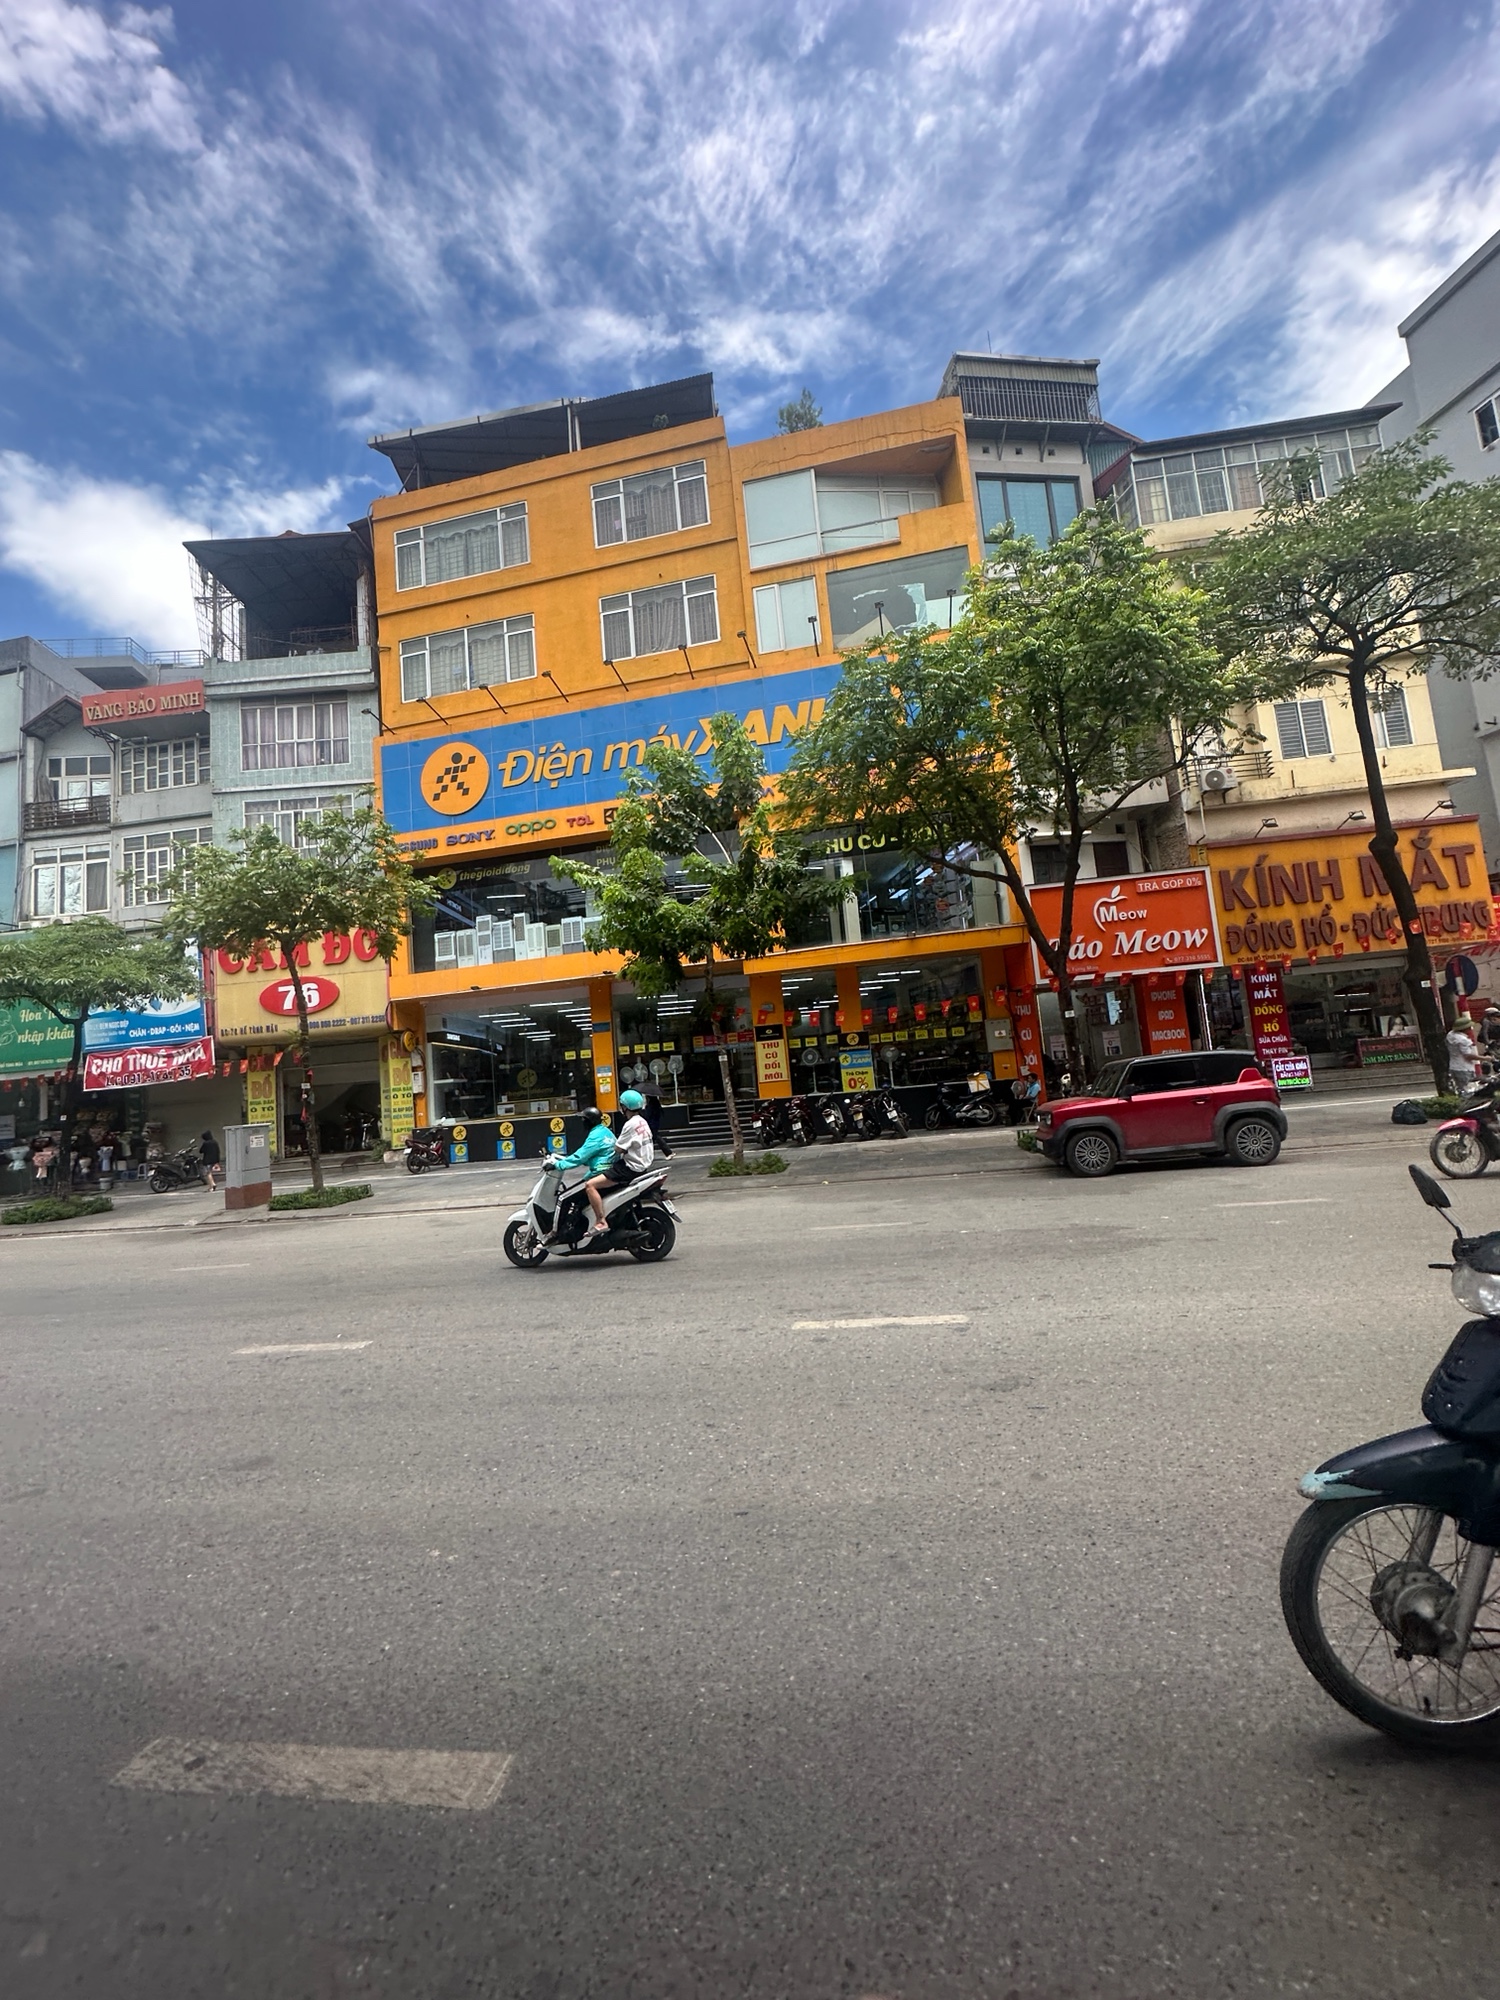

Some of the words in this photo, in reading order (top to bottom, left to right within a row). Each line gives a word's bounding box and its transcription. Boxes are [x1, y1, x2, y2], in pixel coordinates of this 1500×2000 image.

[86, 700, 124, 720] VÀNG
[127, 692, 156, 715] BẢO
[160, 692, 201, 710] MINH
[498, 741, 593, 789] Điện
[566, 815, 595, 828] TCL
[459, 863, 532, 882] thegioididong
[1219, 854, 1345, 911] KÍNH
[1358, 829, 1476, 898] MẮT
[1186, 876, 1203, 888] 0%
[1100, 905, 1148, 923] Meow
[1226, 911, 1297, 954] ĐỒNG
[1301, 904, 1338, 949] HỒ
[1112, 928, 1209, 957] Meow
[278, 983, 320, 1010] 76
[1254, 984, 1279, 1000] MẮT
[19, 1009, 42, 1023] Hoa
[1015, 1004, 1031, 1016] THU
[1254, 1001, 1284, 1016] ĐỒNG
[1263, 1018, 1280, 1033] HỒ
[17, 1030, 45, 1046] nhập
[46, 1024, 75, 1040] khẩu
[761, 1041, 780, 1050] THU
[91, 1057, 123, 1076] CHO
[127, 1049, 168, 1072] THUÊ
[765, 1051, 778, 1060] CŨ
[764, 1060, 781, 1070] ĐỔI
[764, 1071, 783, 1080] MỚI
